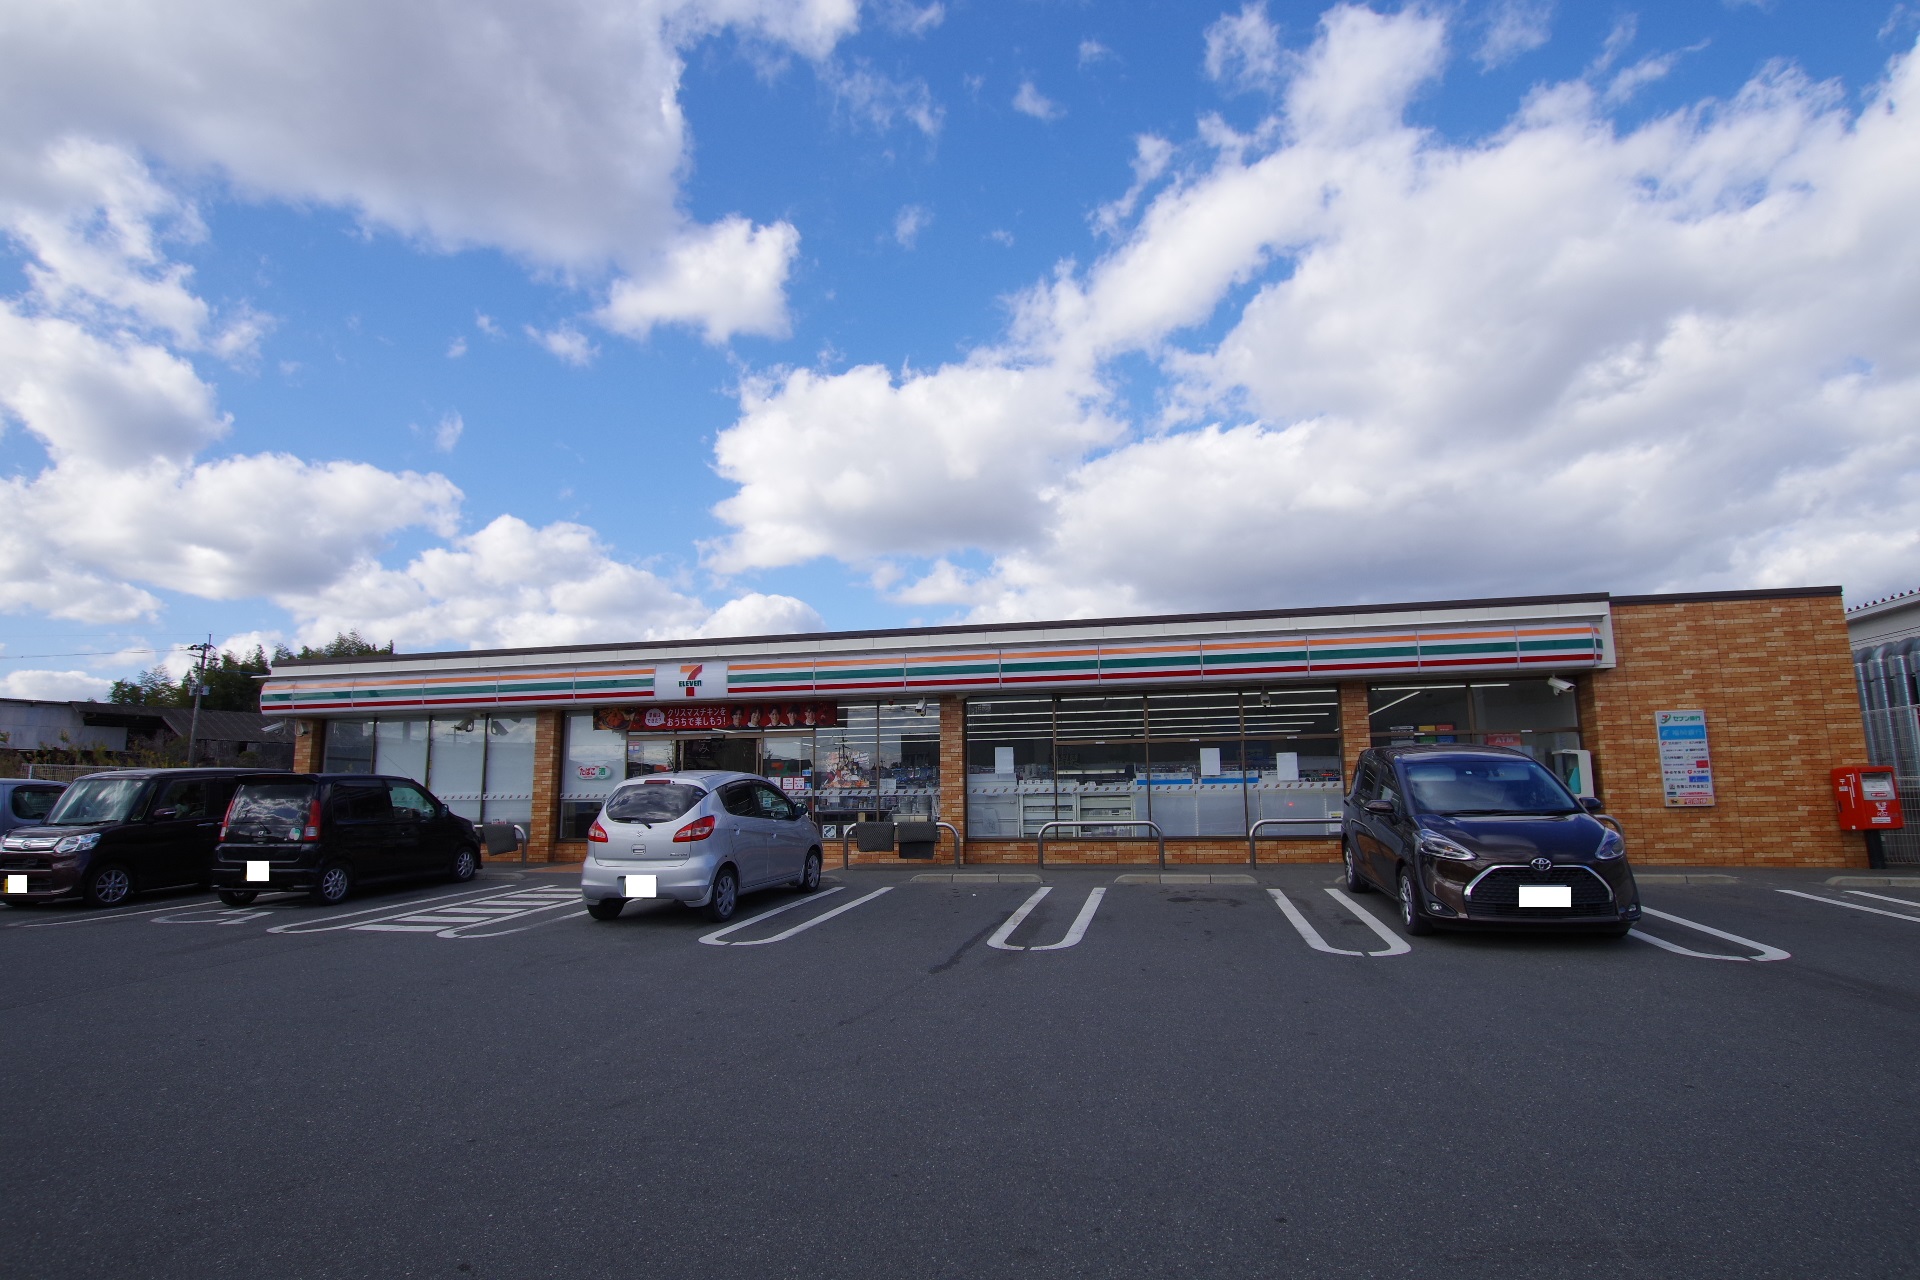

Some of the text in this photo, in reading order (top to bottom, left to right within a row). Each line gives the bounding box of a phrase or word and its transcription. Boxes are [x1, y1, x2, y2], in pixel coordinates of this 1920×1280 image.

[667, 707, 727, 717] クリスマスチキンを
[667, 717, 726, 727] おうちで楽しもう!
